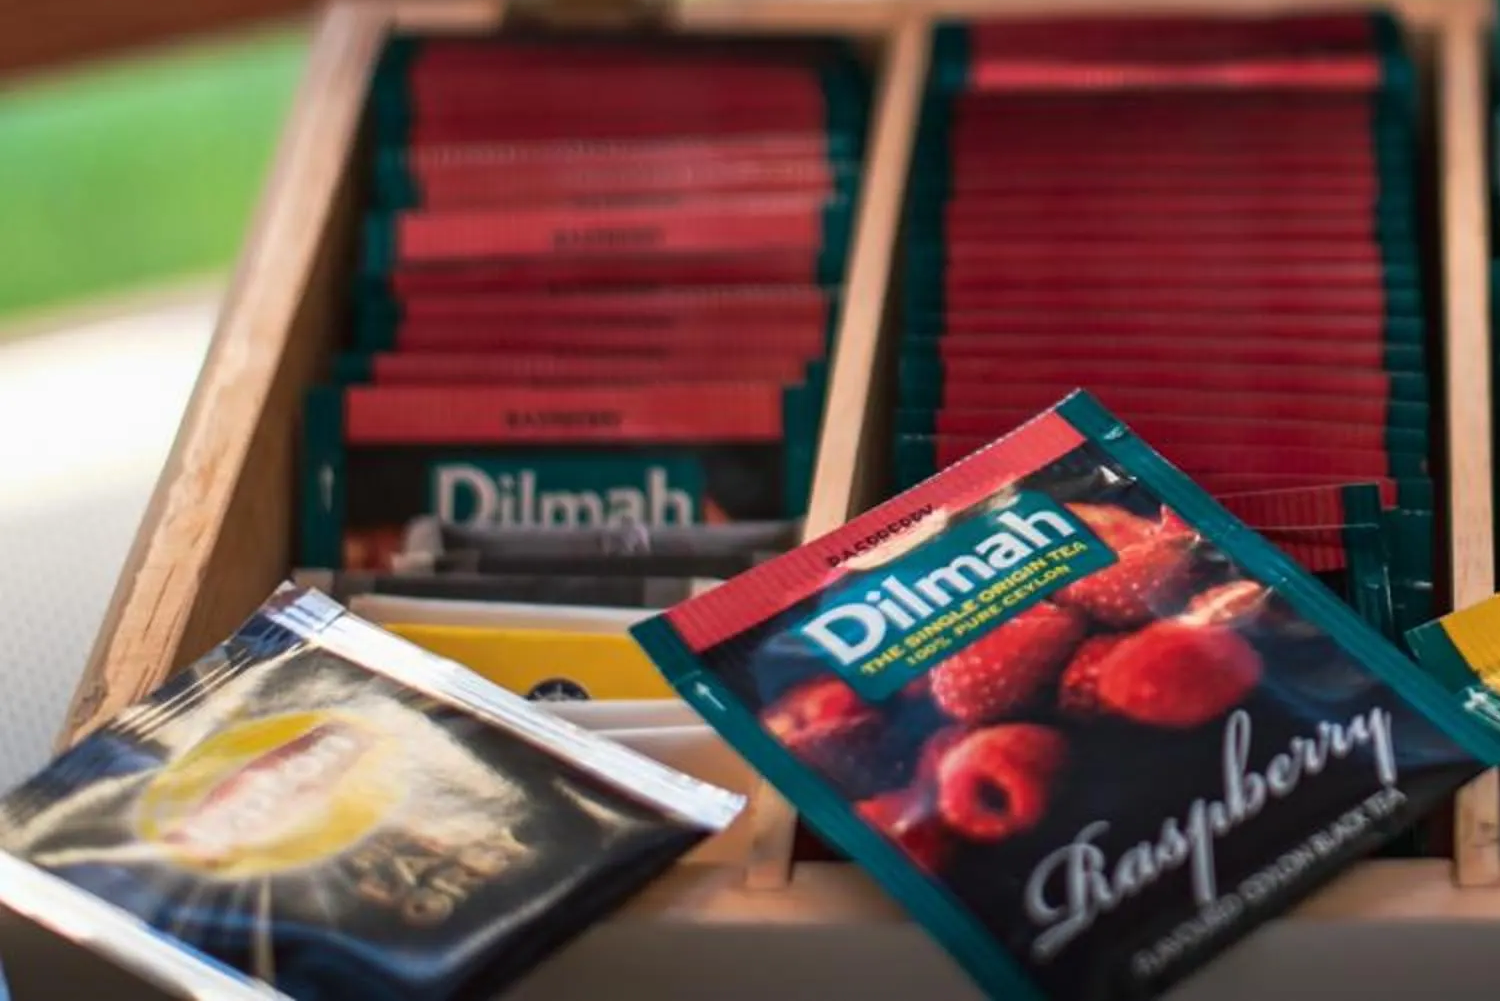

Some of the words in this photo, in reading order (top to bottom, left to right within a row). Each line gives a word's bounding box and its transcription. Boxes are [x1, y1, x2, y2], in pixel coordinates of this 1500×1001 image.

[437, 463, 694, 529] Dilmah
[801, 506, 1077, 666] Dilmah
[861, 644, 904, 675] THE
[904, 599, 978, 648] SINGLE
[977, 558, 1048, 603] ORIGIN
[1046, 540, 1088, 561] TEA
[954, 604, 1002, 637] PURE
[1002, 565, 1071, 606] CEYLON
[1024, 707, 1398, 964] Raspberry
[1312, 810, 1371, 856] BLACK
